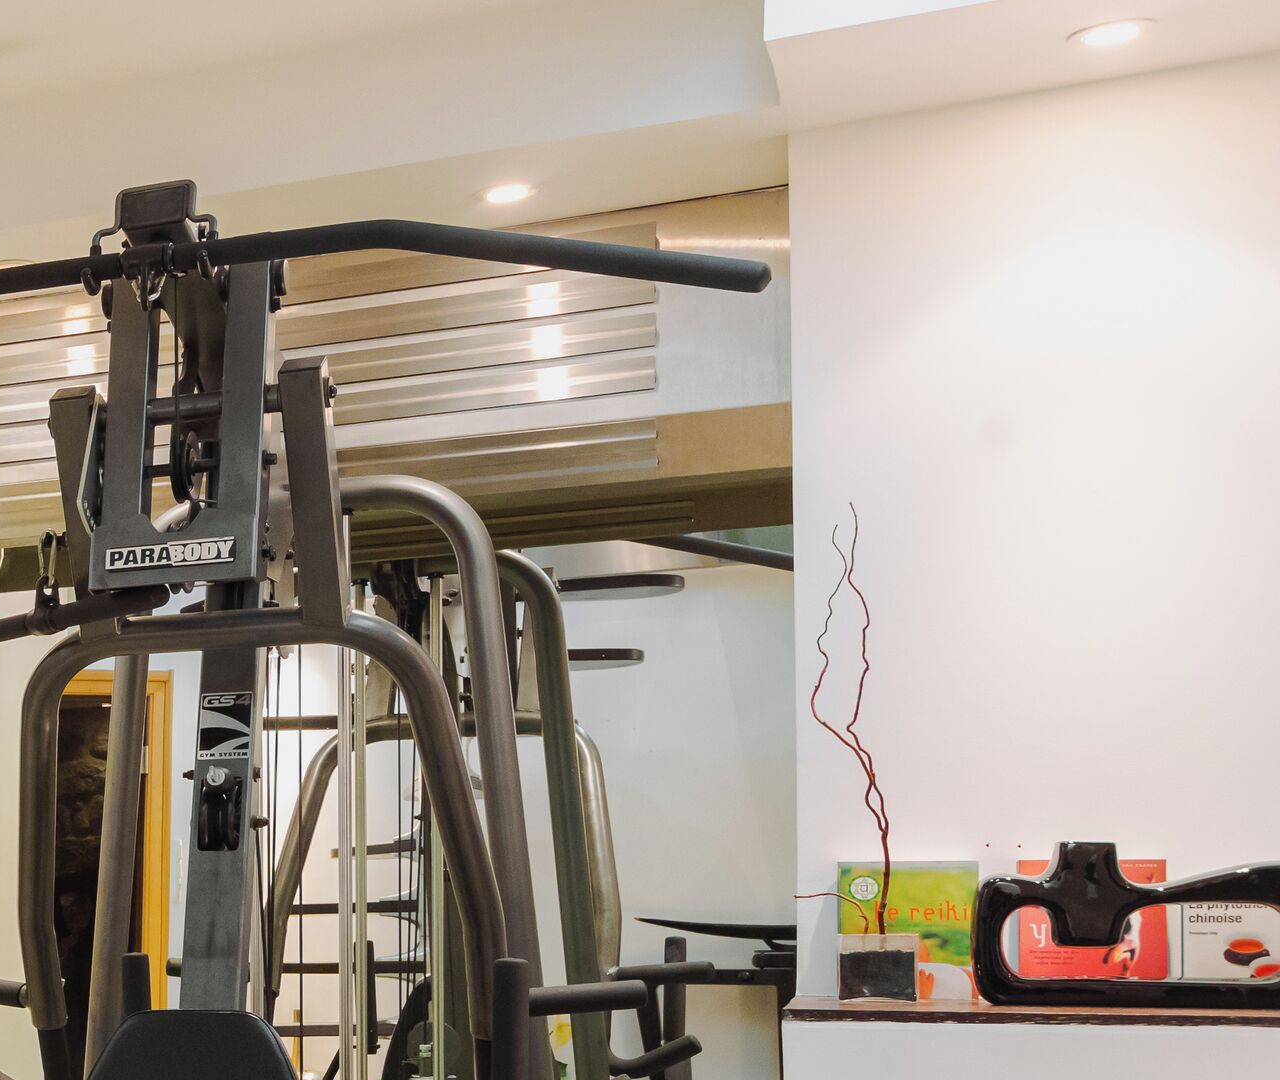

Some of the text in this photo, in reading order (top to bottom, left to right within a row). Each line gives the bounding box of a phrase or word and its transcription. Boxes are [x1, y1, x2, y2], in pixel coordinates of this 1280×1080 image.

[109, 540, 234, 567] PARABODY
[203, 694, 251, 708] GS4
[909, 900, 969, 921] reiki
[1188, 912, 1242, 924] chinoise
